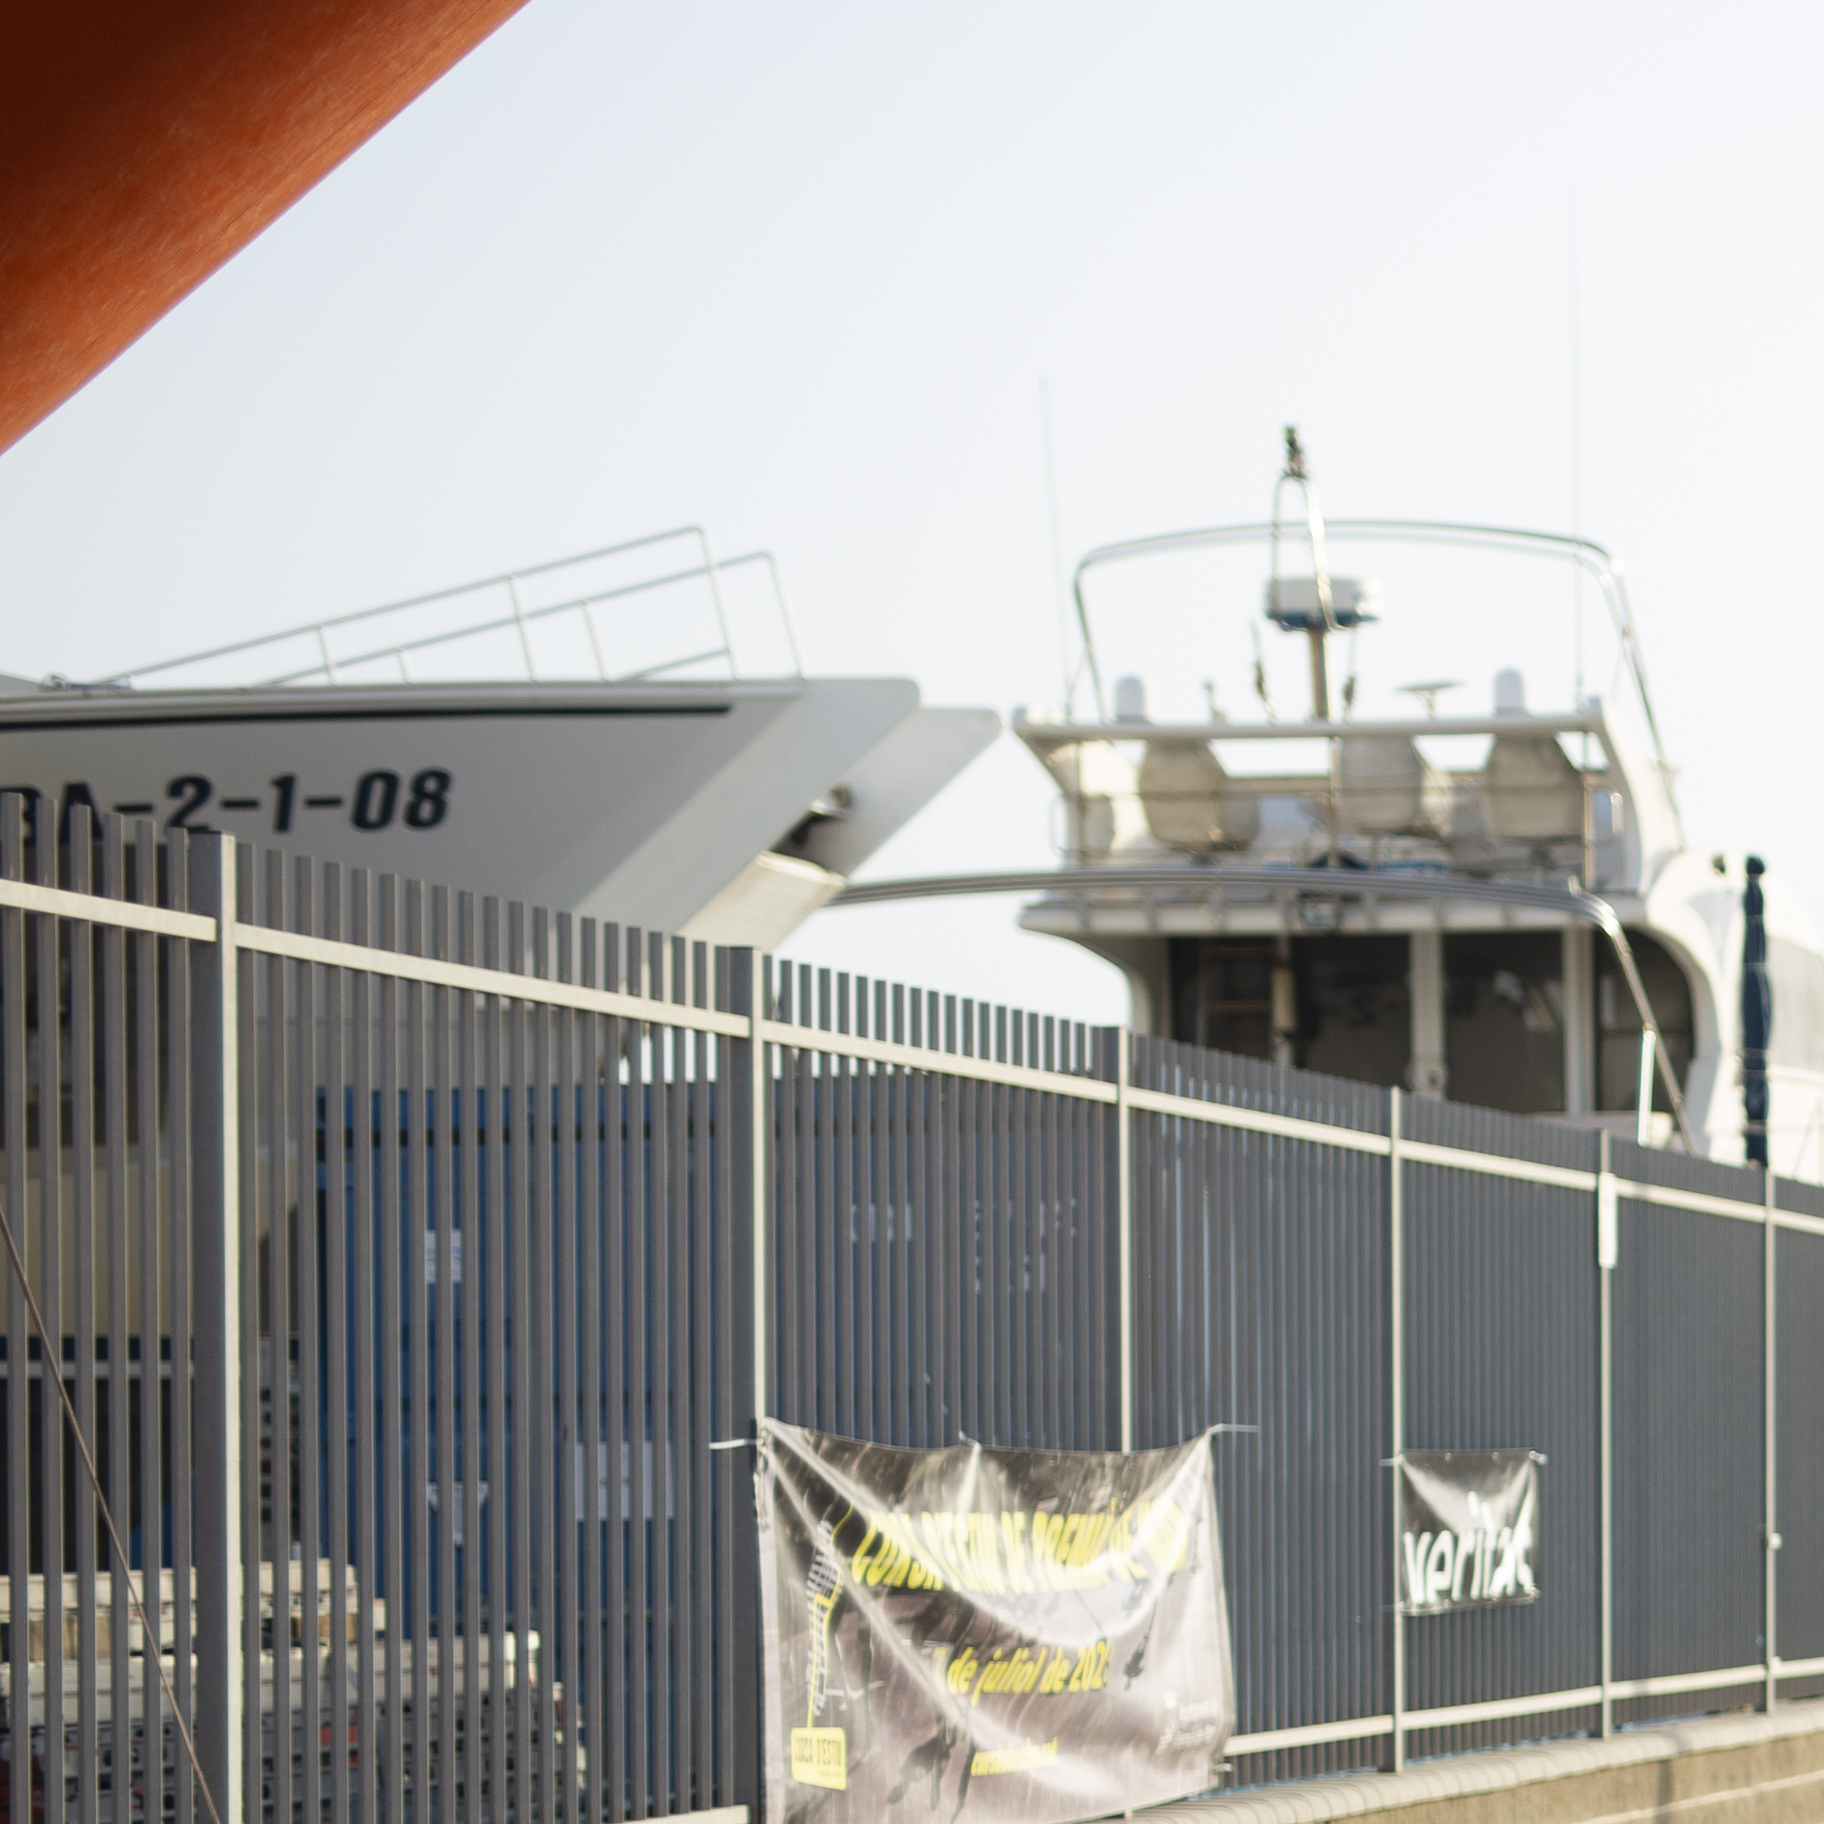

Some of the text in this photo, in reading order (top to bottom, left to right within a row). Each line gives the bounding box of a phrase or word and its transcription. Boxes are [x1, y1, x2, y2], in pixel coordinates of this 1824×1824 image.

[947, 1646, 978, 1695] de
[970, 1646, 1048, 1708] juliol
[1039, 1645, 1070, 1693] de
